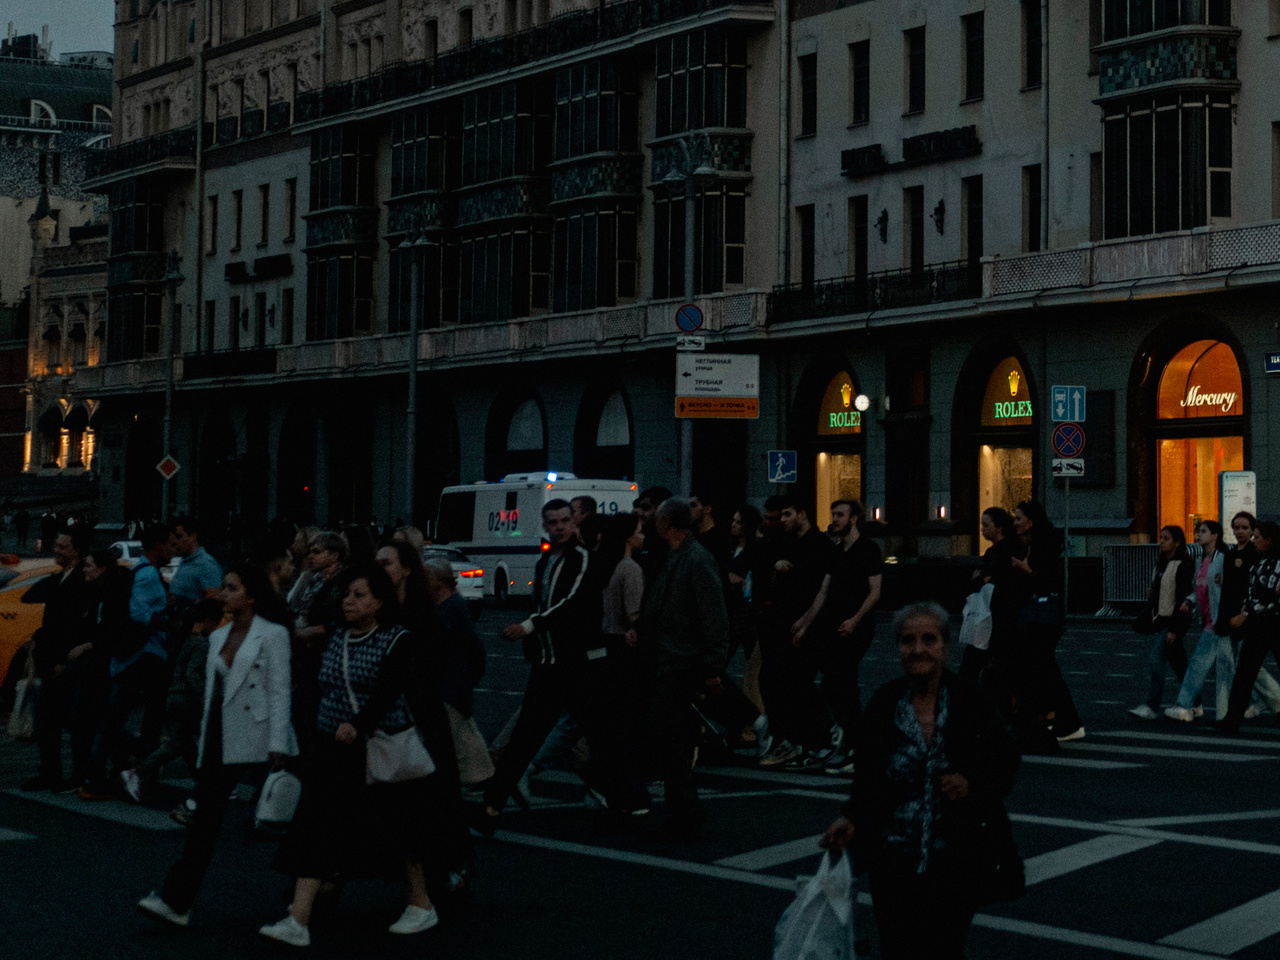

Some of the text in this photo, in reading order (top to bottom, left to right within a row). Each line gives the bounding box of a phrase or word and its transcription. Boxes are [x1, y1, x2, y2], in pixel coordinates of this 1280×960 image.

[1180, 385, 1237, 412] Mercury
[994, 400, 1033, 419] ROLEX
[488, 511, 518, 532] 02-19
